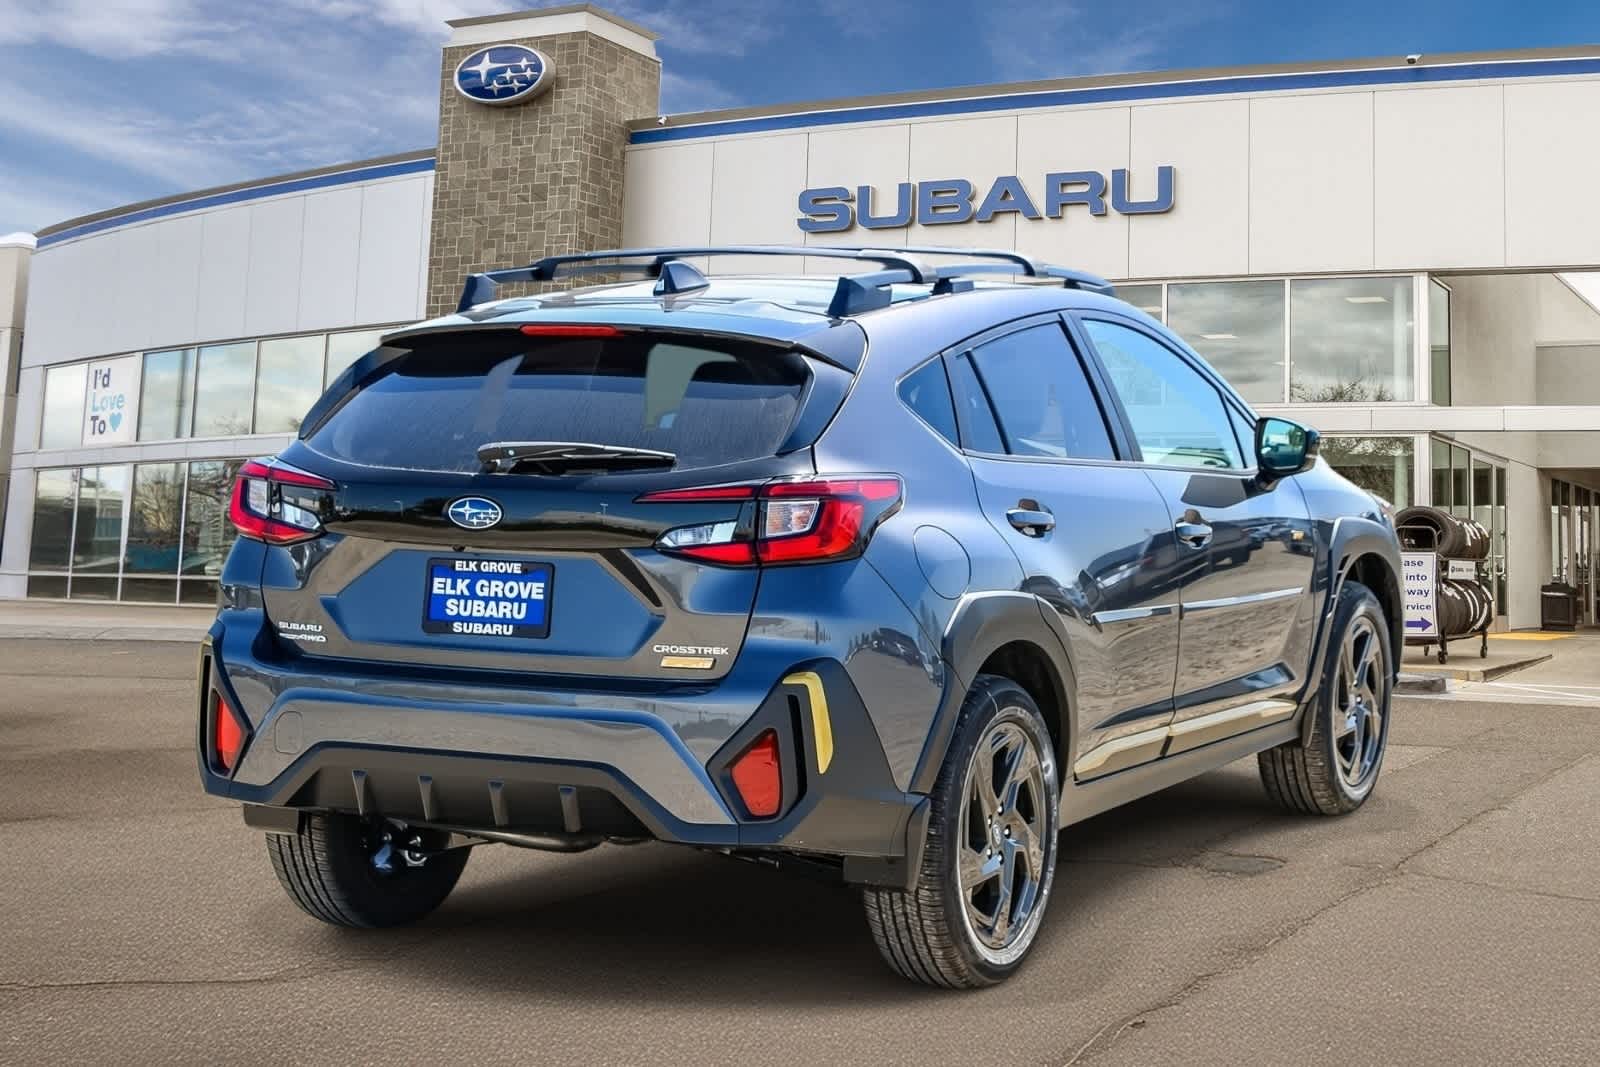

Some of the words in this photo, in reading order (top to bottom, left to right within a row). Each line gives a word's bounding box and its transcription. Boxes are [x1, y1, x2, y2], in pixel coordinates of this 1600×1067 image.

[797, 165, 1177, 233] SUBARU
[93, 367, 112, 390] I'd
[91, 391, 125, 412] Love
[90, 415, 106, 435] To
[455, 560, 478, 572] ELK
[480, 562, 522, 574] GROVE
[1405, 572, 1428, 581] into
[432, 577, 471, 596] ELK
[475, 579, 545, 600] GROVE
[445, 598, 527, 620] SUBARU
[279, 621, 323, 632] SUBARU
[452, 621, 514, 636] SUBARU
[653, 644, 729, 655] CROSSTREK
